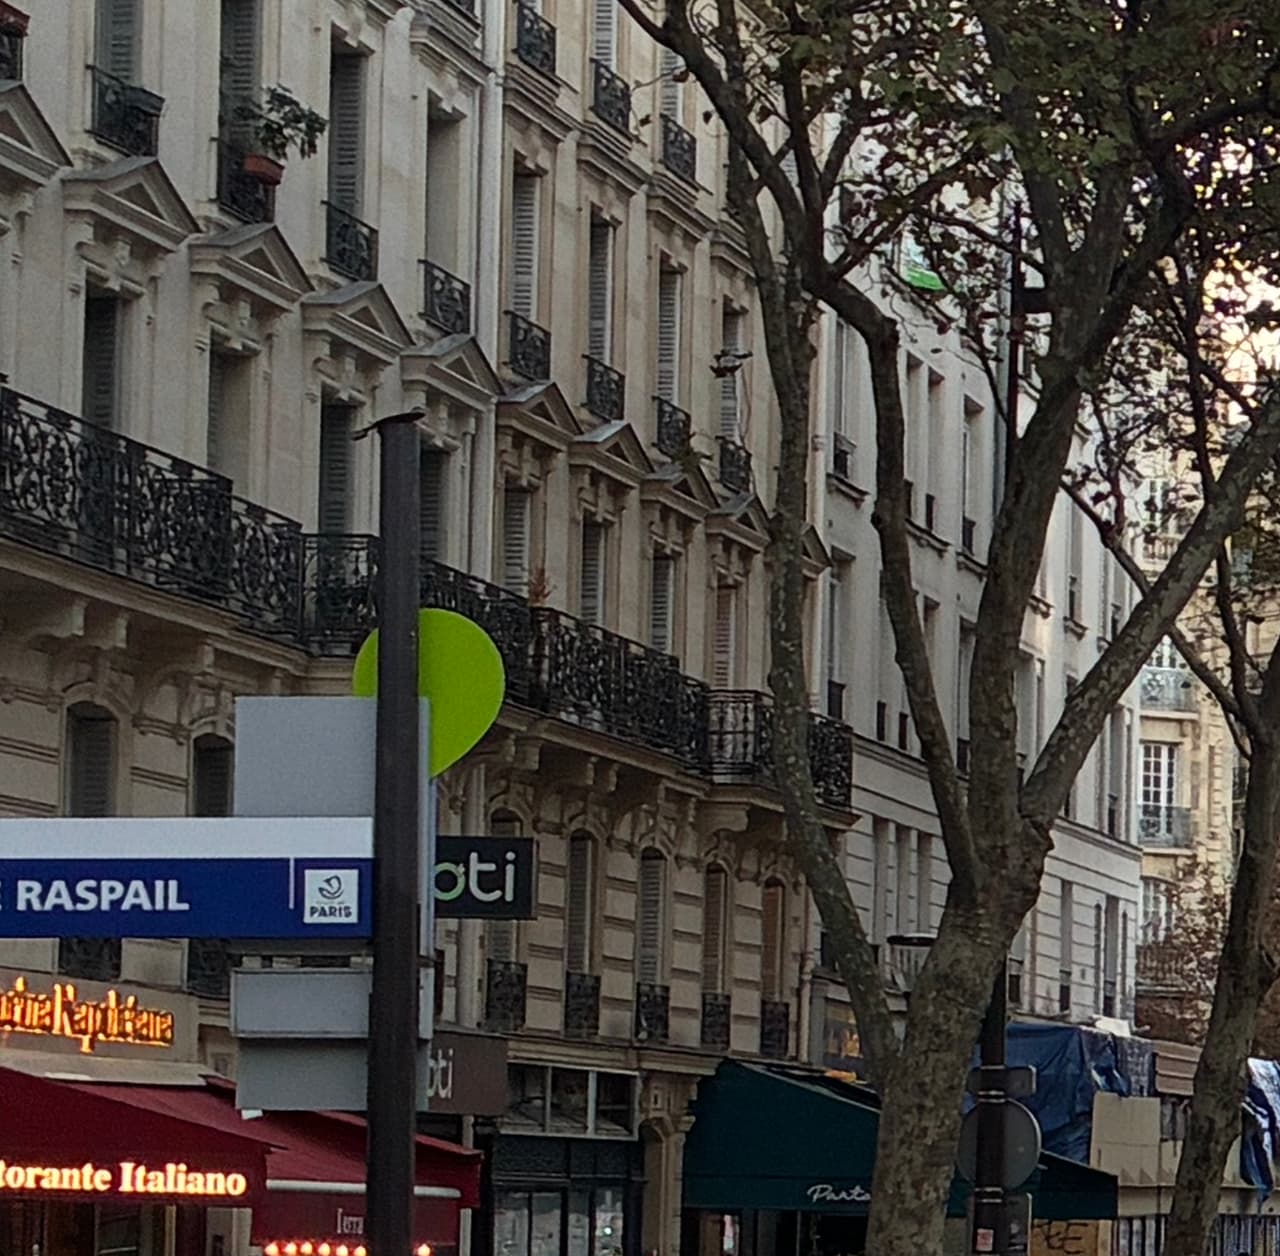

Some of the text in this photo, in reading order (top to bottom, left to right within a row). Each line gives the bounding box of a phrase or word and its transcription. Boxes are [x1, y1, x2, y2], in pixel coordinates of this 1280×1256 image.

[16, 879, 190, 911] RASPAIL
[309, 905, 353, 919] PARIS
[118, 1162, 247, 1196] Italiano
